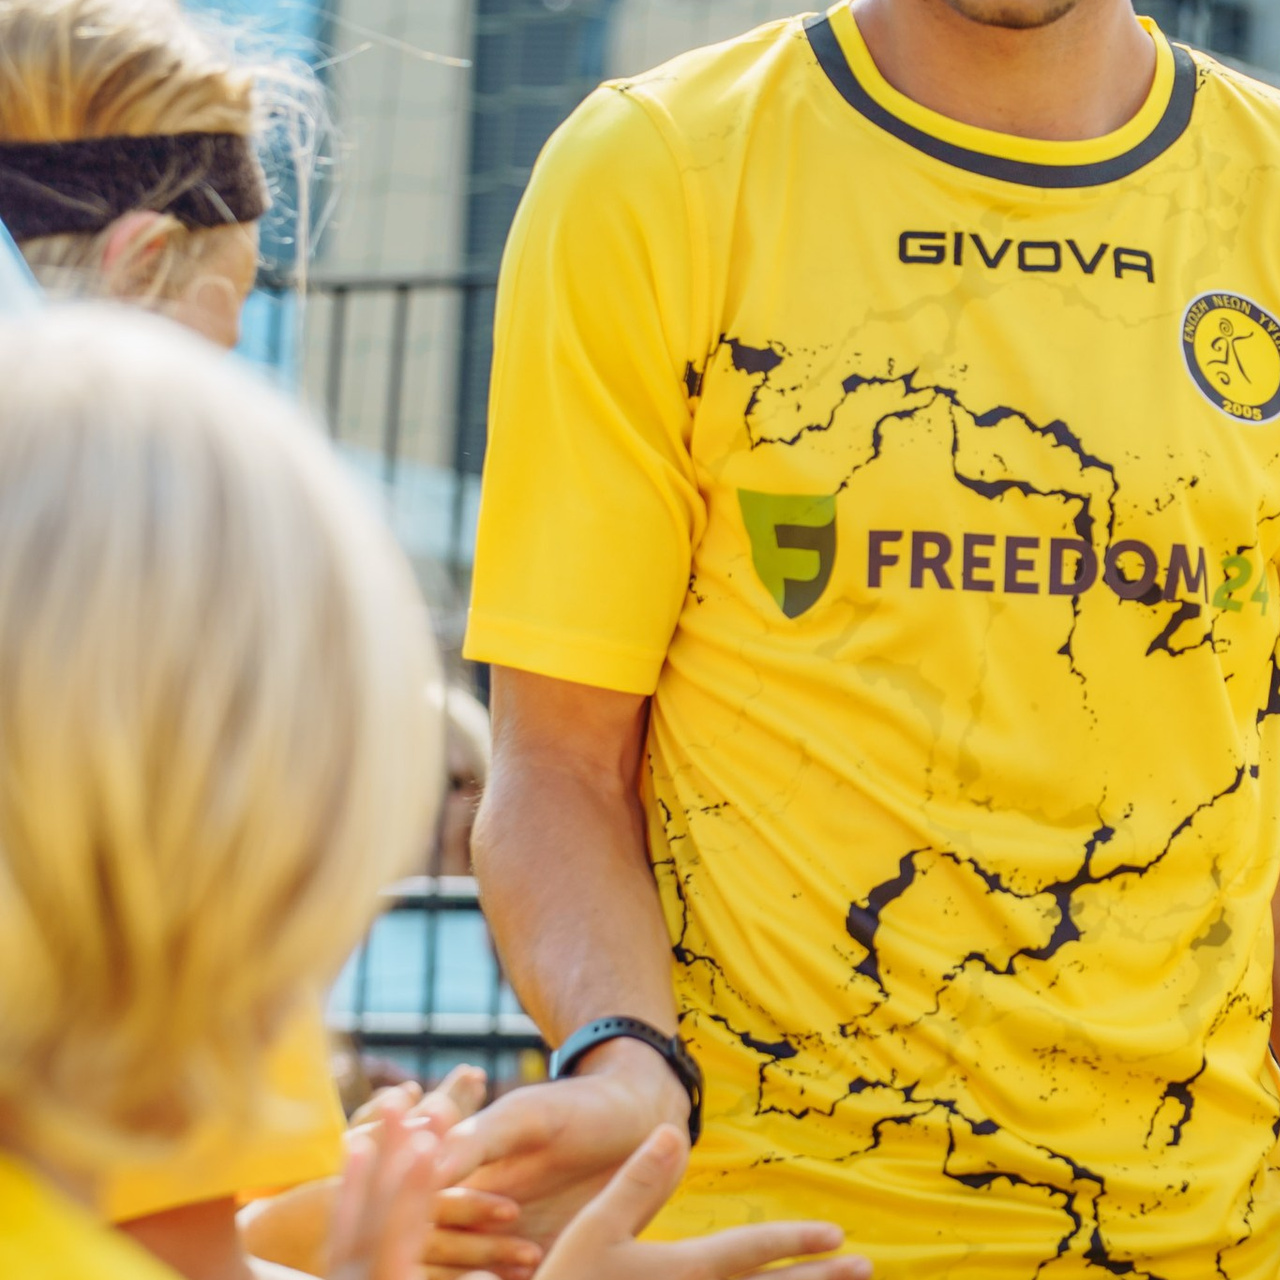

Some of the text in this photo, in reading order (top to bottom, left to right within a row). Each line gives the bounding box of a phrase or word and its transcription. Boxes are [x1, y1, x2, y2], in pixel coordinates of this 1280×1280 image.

[898, 230, 1155, 283] GIVOVA
[1212, 295, 1252, 315] ΝΕΩΝ
[1221, 400, 1263, 421] 2005
